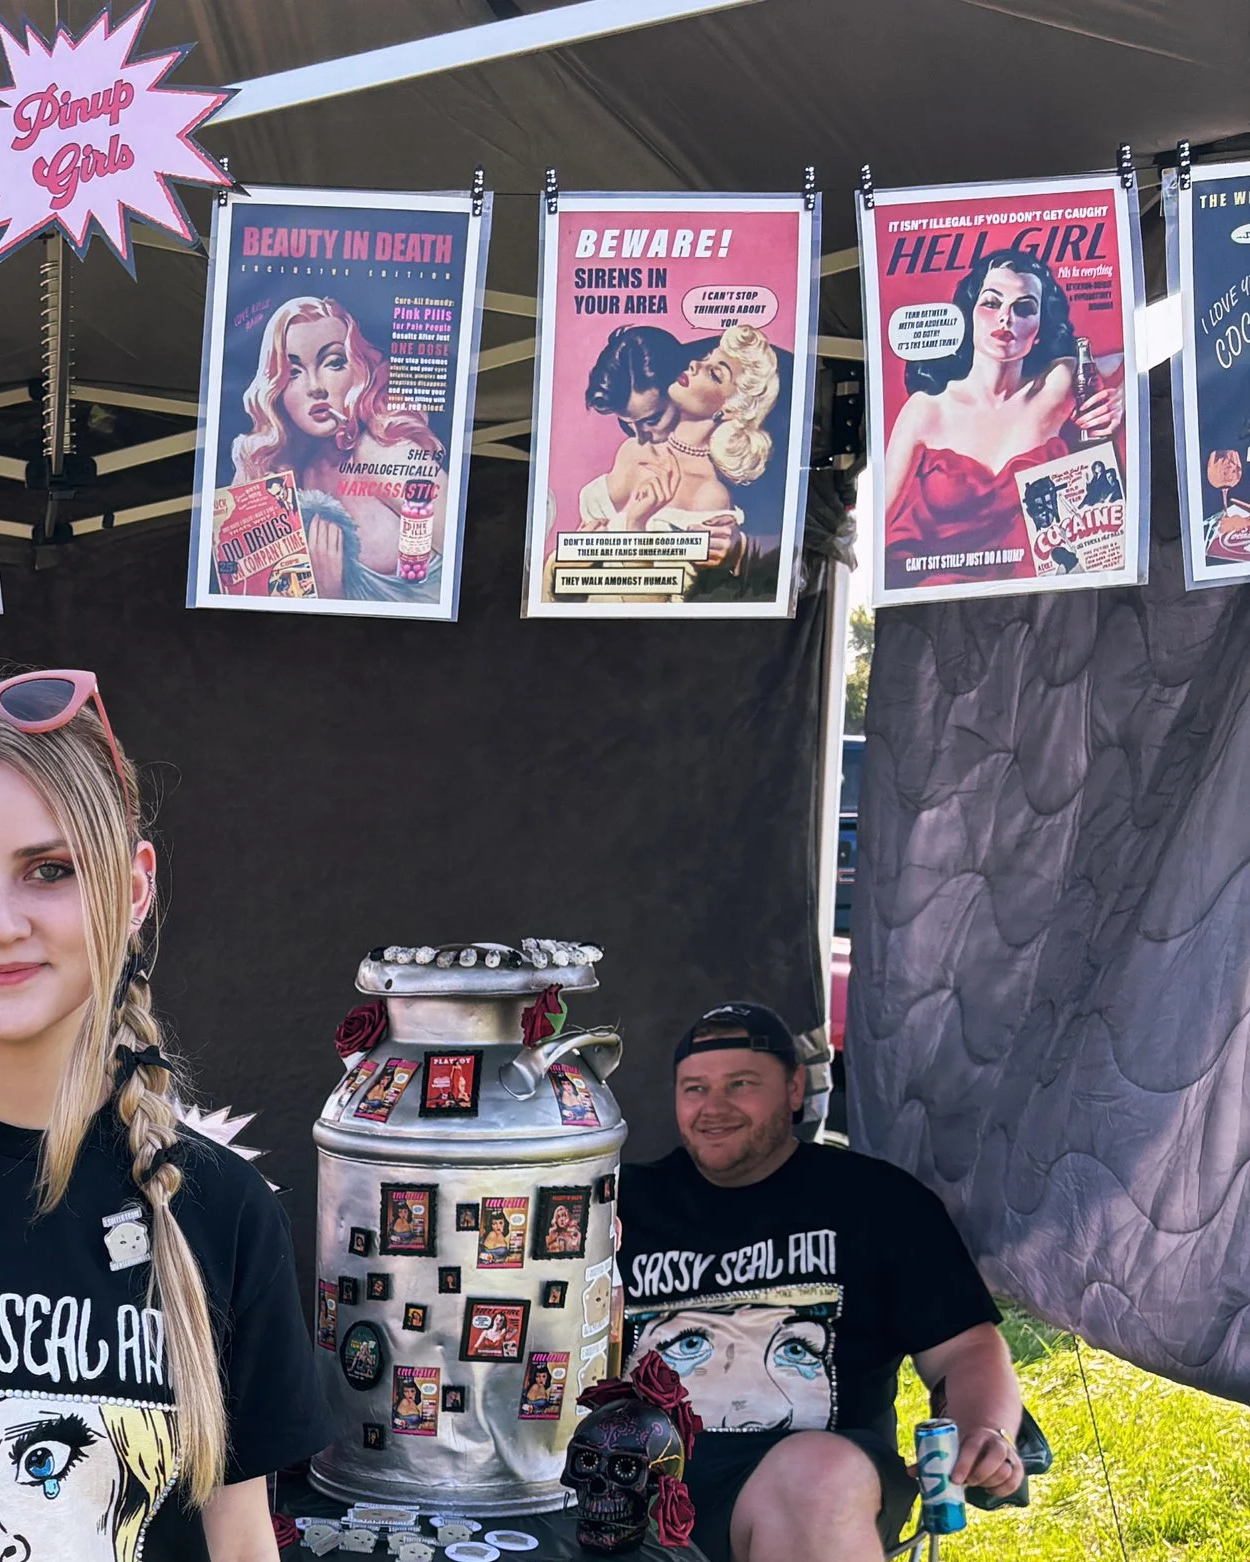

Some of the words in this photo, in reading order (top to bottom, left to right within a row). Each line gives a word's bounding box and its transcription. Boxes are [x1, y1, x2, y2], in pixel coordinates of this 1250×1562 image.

[11, 79, 134, 150] Pinup
[32, 134, 134, 210] Girls
[1200, 193, 1226, 208] THE
[888, 221, 899, 233] IT
[900, 218, 927, 232] ISN'T
[929, 216, 972, 230] ILLEGAL
[973, 213, 984, 226] IF
[984, 212, 1008, 224] YOU
[1009, 210, 1042, 223] DON'T
[1043, 208, 1063, 221] GET
[1064, 206, 1108, 220] CAUGHT
[243, 227, 339, 259] BEAUTY
[343, 231, 369, 261] IN
[375, 232, 452, 264] DEATH
[575, 229, 733, 258] BEWARE!
[886, 229, 990, 277] HELL
[1010, 222, 1108, 263] GIRL
[574, 268, 642, 289] SIRENS
[648, 268, 667, 288] IN
[1081, 264, 1113, 278] everything
[574, 295, 620, 314] YOUR
[624, 295, 668, 314] AREA
[708, 291, 734, 300] CAN'T
[735, 291, 758, 300] STOP
[1210, 285, 1238, 326] LOVE
[394, 308, 420, 319] Pink
[424, 308, 452, 321] Pills
[694, 305, 735, 314] THINKING
[737, 305, 766, 314] ABOUT
[391, 342, 413, 354] ONE
[418, 344, 449, 356] DOSE
[407, 449, 430, 461] SHE
[434, 450, 442, 461] IS
[339, 464, 441, 477] UNAPOLOGETICALLY
[336, 480, 440, 498] NARCISSISTIC
[222, 538, 244, 561] DO
[243, 513, 292, 553] DRUGS
[1037, 506, 1123, 553] COCAINE
[563, 538, 583, 546] DON'T
[596, 538, 621, 546] FOOLED
[634, 538, 653, 546] THEIR
[655, 537, 675, 546] GOOD
[243, 542, 284, 573] COMPANY
[906, 555, 926, 572] CAN'T
[927, 554, 940, 570] SIT
[941, 553, 965, 569] STILL?
[966, 552, 983, 567] JUST
[985, 551, 996, 565] DO
[1002, 549, 1024, 564] BUMP
[561, 577, 580, 586] THEY
[581, 576, 603, 586] WALK
[605, 576, 642, 586] AMONGST
[644, 576, 679, 586] HUMANS.
[628, 1250, 716, 1297] SASSY
[714, 1239, 783, 1287] SEAL
[788, 1229, 837, 1275] ART
